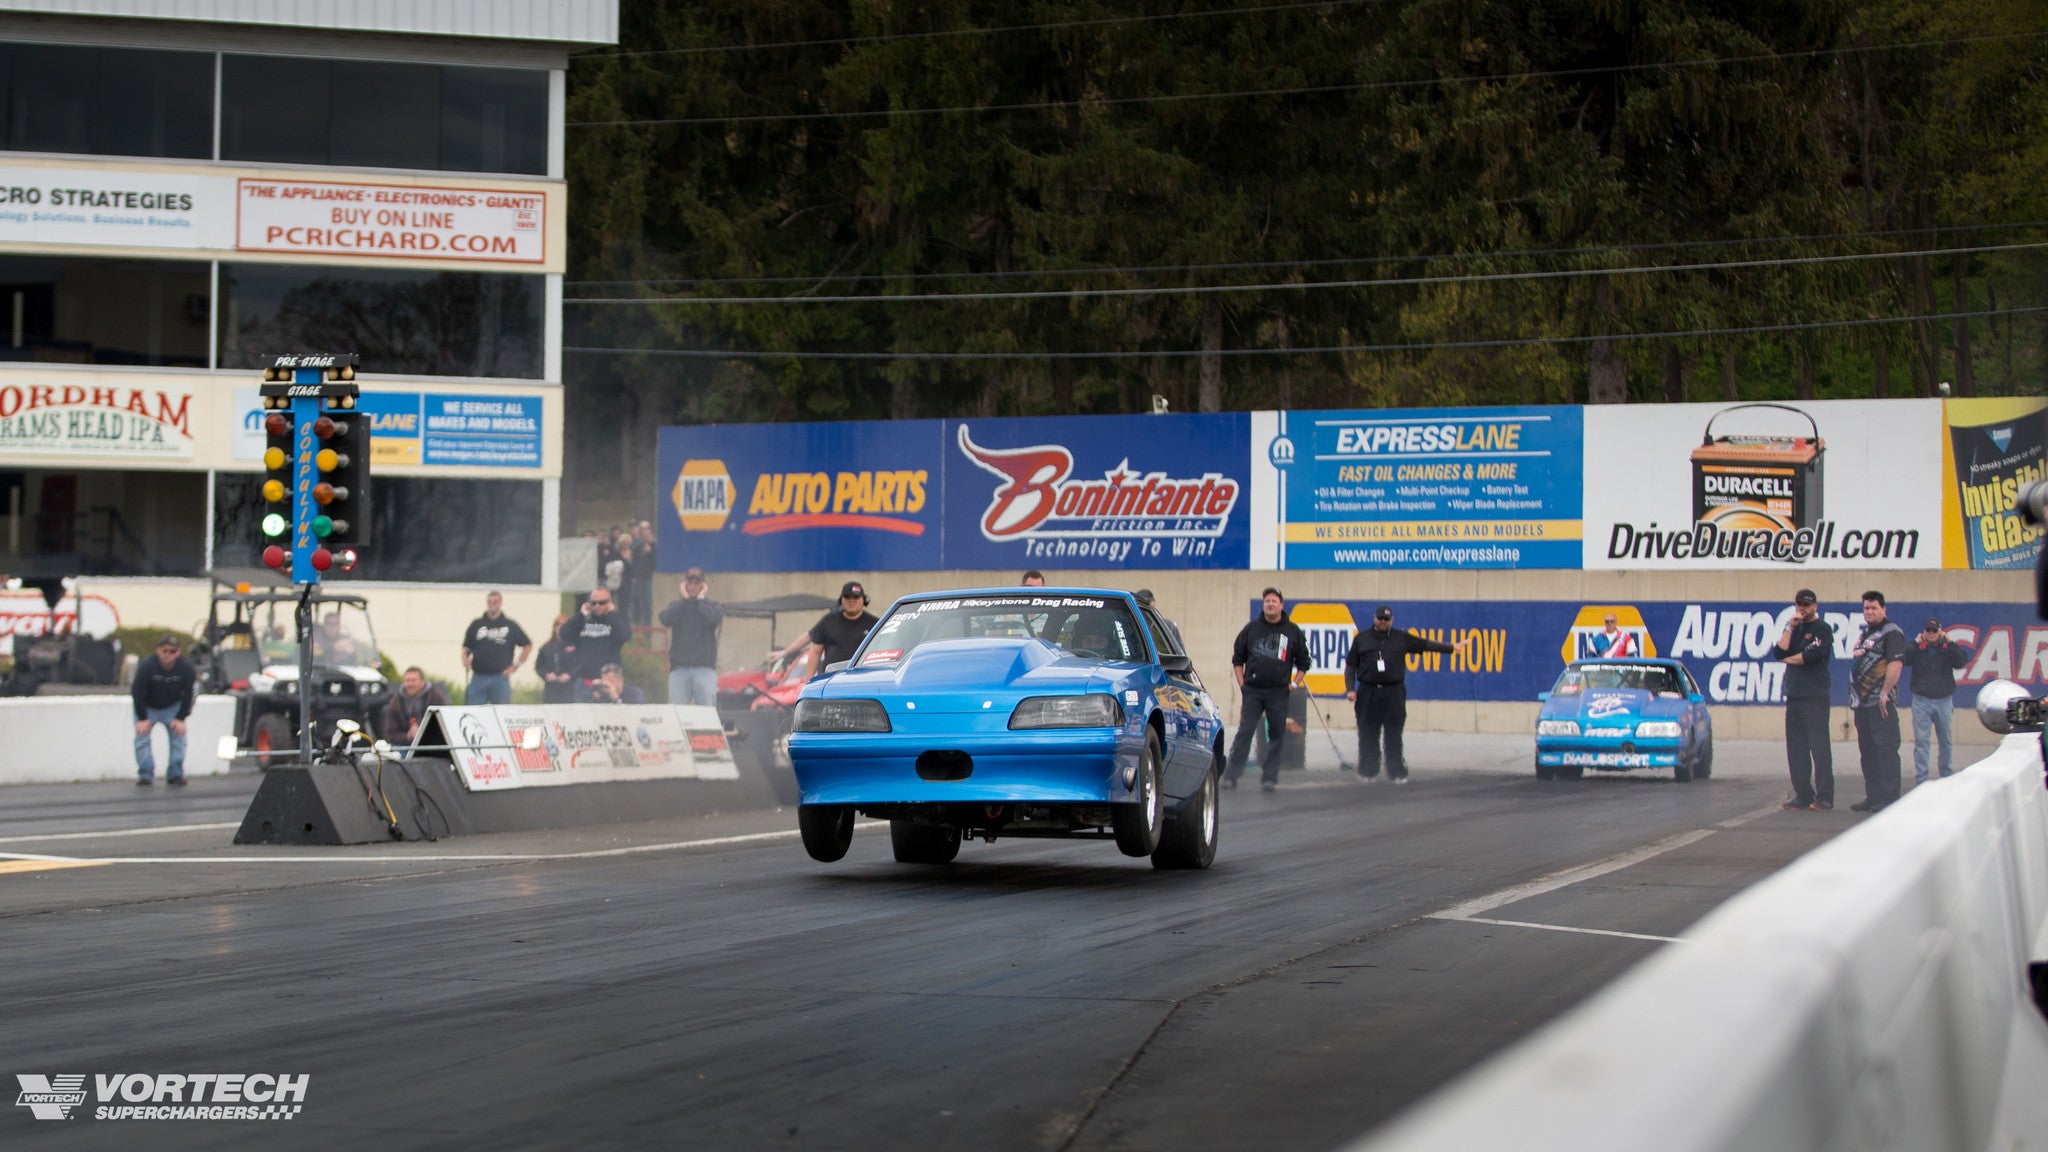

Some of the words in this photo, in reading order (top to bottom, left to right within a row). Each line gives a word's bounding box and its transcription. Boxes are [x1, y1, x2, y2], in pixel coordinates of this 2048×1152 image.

[50, 188, 193, 211] STRATEGIES
[280, 187, 364, 202] APPLIANCE
[375, 191, 475, 207] ELECTRONICS
[331, 208, 371, 226] BUY
[376, 210, 405, 227] ON
[412, 211, 454, 229] LINE
[267, 226, 517, 254] PCRICHARD.COM
[275, 356, 335, 368] PRE-STAGE
[287, 385, 322, 396] STAGE
[0, 384, 193, 439] ORDHAM
[462, 402, 502, 415] SERVICE
[504, 403, 524, 415] ALL
[0, 412, 61, 439] RAMS
[68, 410, 123, 440] HEAD
[129, 417, 164, 442] IPA
[428, 416, 466, 429] MAKES
[468, 417, 490, 430] AND
[1336, 424, 1521, 454] EXPRESSLANE
[959, 424, 1238, 540] Boninfante
[1339, 465, 1371, 483] FAST
[1374, 465, 1394, 482] OIL
[1397, 463, 1460, 482] CHANGES
[1462, 464, 1474, 480] &
[1477, 463, 1517, 480] MORE
[297, 422, 311, 549] COMPULINK
[683, 479, 728, 510] NAPA
[747, 472, 830, 515] AUTO
[832, 470, 928, 513] PARTS
[1319, 487, 1329, 498] Oil
[1337, 487, 1353, 497] Filter
[1355, 487, 1385, 499] Changes
[1401, 486, 1438, 497] Multi-Point
[1439, 486, 1470, 498] Checkup
[1486, 485, 1512, 496] Battery
[1513, 484, 1528, 495] Test
[1705, 476, 1793, 497] DURACELL
[1961, 458, 2048, 518] Invis
[1319, 501, 1332, 511] Tire
[1333, 501, 1361, 511] Rotation
[1362, 501, 1377, 511] with
[1378, 500, 1399, 510] Brake
[1400, 500, 1436, 511] Inspection
[1452, 500, 1474, 511] Wiper
[1475, 499, 1495, 509] Blade
[1496, 499, 1543, 510] Replacement
[1092, 519, 1165, 530] Friction
[1175, 519, 1208, 530] Inc.
[1315, 526, 1333, 538] WE
[1338, 525, 1386, 538] SERVICE
[1392, 525, 1412, 537] ALL
[1417, 525, 1458, 537] MAKES
[1464, 525, 1489, 536] AND
[1494, 524, 1544, 536] MODELS
[1025, 538, 1131, 561] Technology
[1141, 538, 1161, 556] To
[1172, 537, 1216, 556] Win!
[1608, 520, 1919, 560] DriveDuracell.com
[1334, 545, 1520, 565] www.mopar.com/expresslane
[917, 600, 960, 612] NMRA
[1031, 598, 1060, 608] Drag
[1061, 598, 1104, 609] Racing
[881, 620, 901, 635] 2
[1670, 604, 1867, 660] AUTOCRE
[1405, 628, 1444, 672] OW
[1450, 628, 1507, 673] HOW
[1709, 661, 1788, 703] CENT
